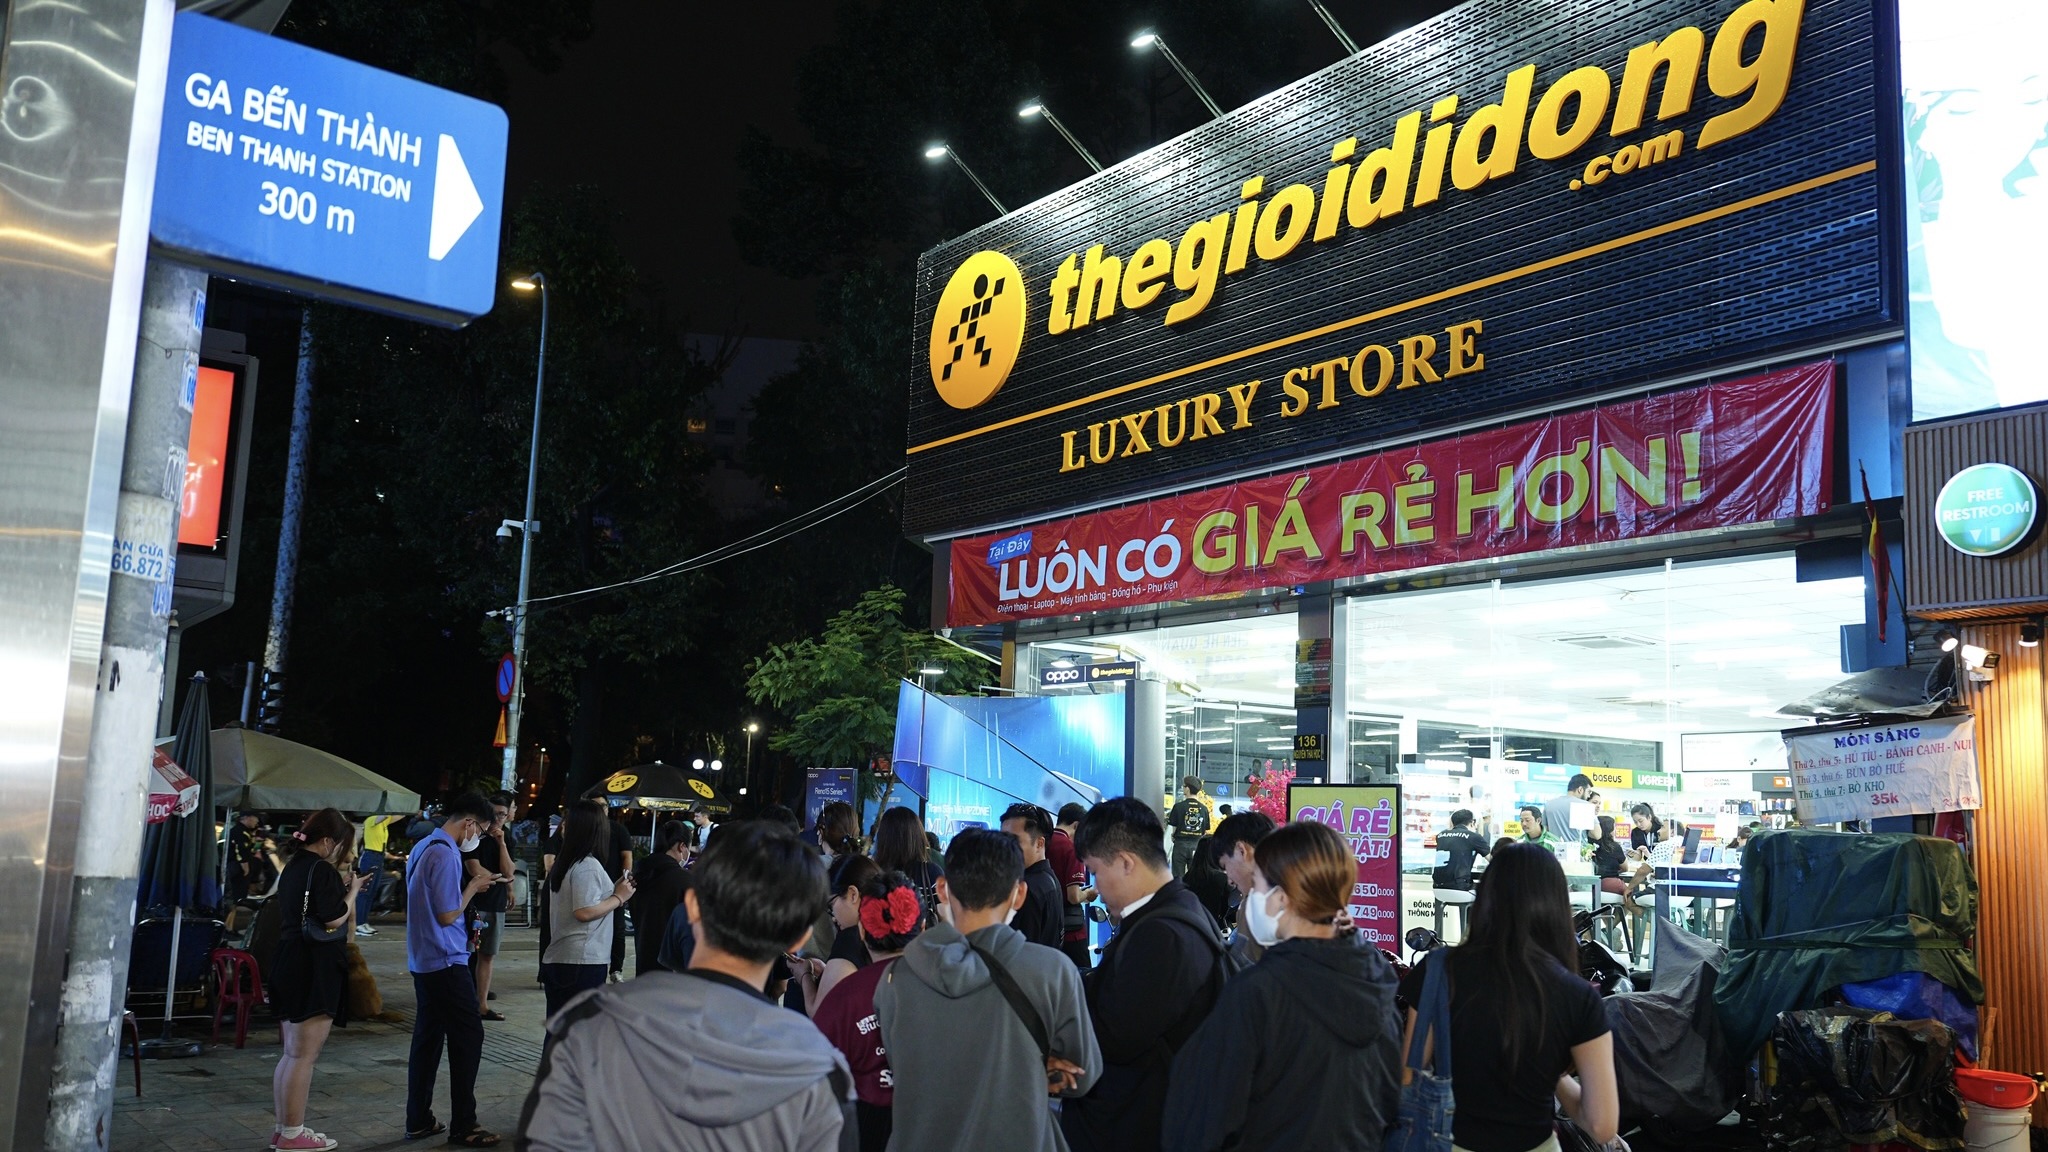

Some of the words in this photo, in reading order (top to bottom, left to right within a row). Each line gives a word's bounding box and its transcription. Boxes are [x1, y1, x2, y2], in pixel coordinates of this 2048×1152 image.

[185, 72, 232, 115] GA
[242, 84, 307, 135] BẾN
[316, 112, 422, 167] THÀNH
[186, 120, 234, 155] BEN
[239, 134, 317, 178] THANH
[321, 158, 412, 203] STATION
[1047, 0, 1804, 335] thegioididong
[1568, 130, 1684, 190] .com
[258, 181, 317, 225] 300
[326, 204, 355, 235] m
[1059, 380, 1261, 473] LUXURY
[1281, 319, 1485, 417] STORE
[1191, 476, 1322, 574] GIÁ
[1340, 463, 1436, 553] RẺ
[1457, 431, 1702, 537] HƠN!
[1968, 487, 2004, 503] FREE
[1943, 501, 2030, 522] RESTROOM
[139, 542, 164, 558] CỬA
[989, 543, 1004, 559] Tại
[1007, 537, 1031, 553] Đây
[111, 552, 163, 578] 66.872
[999, 540, 1108, 601] LUÔN
[1116, 518, 1181, 583] CÓ
[997, 604, 1013, 614] Điện
[1014, 601, 1029, 612] thoại
[1033, 599, 1055, 610] Laptop
[1060, 596, 1073, 607] Máy
[1074, 594, 1088, 604] tính
[1089, 591, 1106, 603] bảng
[1112, 587, 1130, 599] Đồng
[1131, 584, 1141, 595] hồ
[1147, 582, 1162, 594] Phụ
[1163, 580, 1178, 591] kiện
[1046, 670, 1079, 683] oppo
[1298, 735, 1316, 747] 136
[1834, 732, 1870, 748] MÓN
[1874, 727, 1921, 743] SÁNG
[1886, 745, 1914, 759] BÁNH
[1916, 742, 1945, 756] CANH
[1953, 739, 1972, 751] NUI
[1592, 773, 1622, 783] baseus
[1869, 763, 1883, 776] BÒ
[1886, 760, 1905, 775] HUẾ
[1637, 774, 1677, 787] UGREEN
[1848, 781, 1862, 794] BÒ
[1864, 780, 1885, 793] KHO
[1871, 792, 1899, 806] 35k
[1297, 800, 1345, 835] GIÁ
[1350, 799, 1392, 835] RẺ
[1437, 831, 1470, 839] GARMIN
[1347, 835, 1391, 863] HẬT!
[1408, 909, 1429, 917] THÔNG
